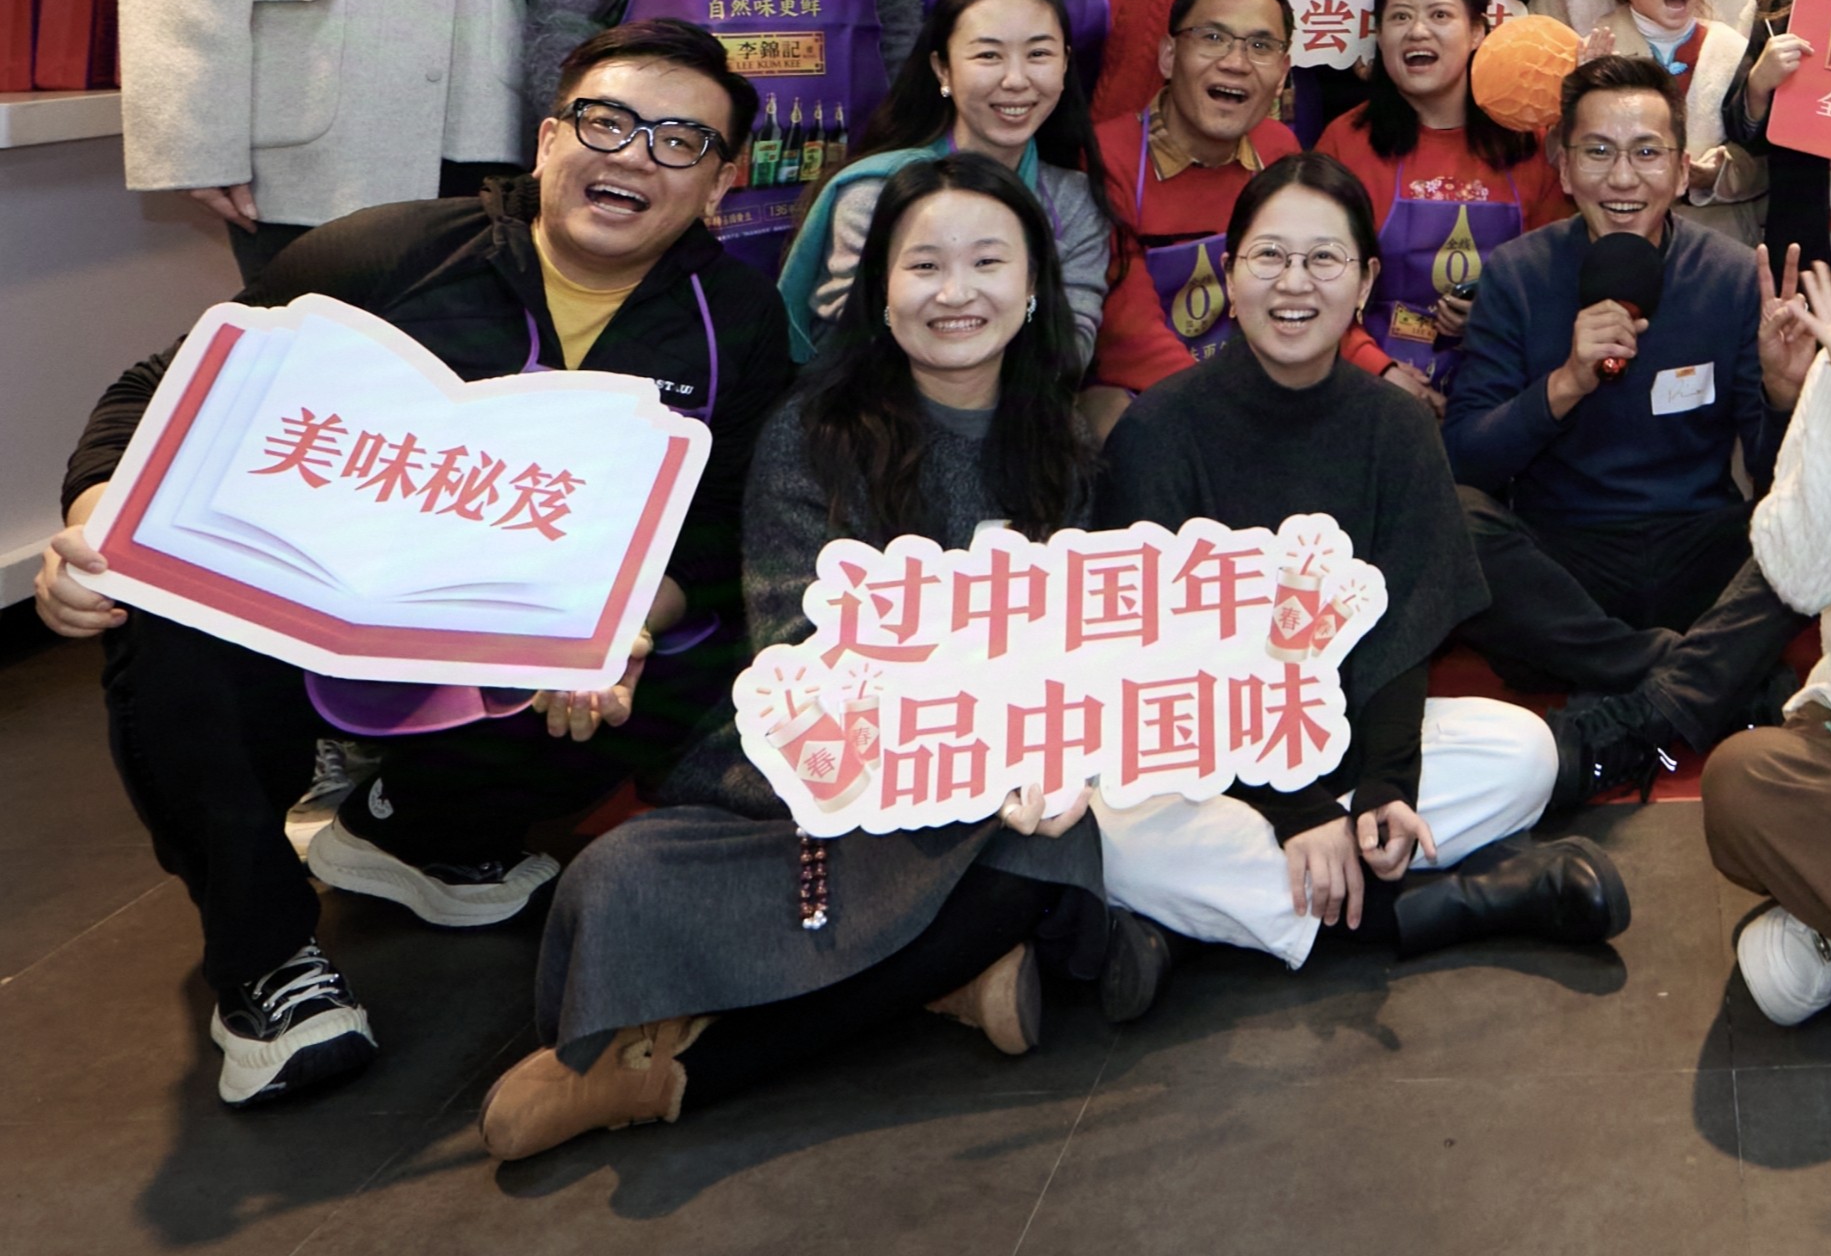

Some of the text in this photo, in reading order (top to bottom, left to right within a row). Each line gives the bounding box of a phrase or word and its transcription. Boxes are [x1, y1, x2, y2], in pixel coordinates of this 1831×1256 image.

[737, 40, 800, 60] 李錦記
[249, 406, 586, 541] 美味秘笈
[819, 539, 1273, 669] 过中国年
[1279, 607, 1300, 630] 春
[804, 747, 836, 778] 春
[880, 661, 1330, 810] 品中国味
